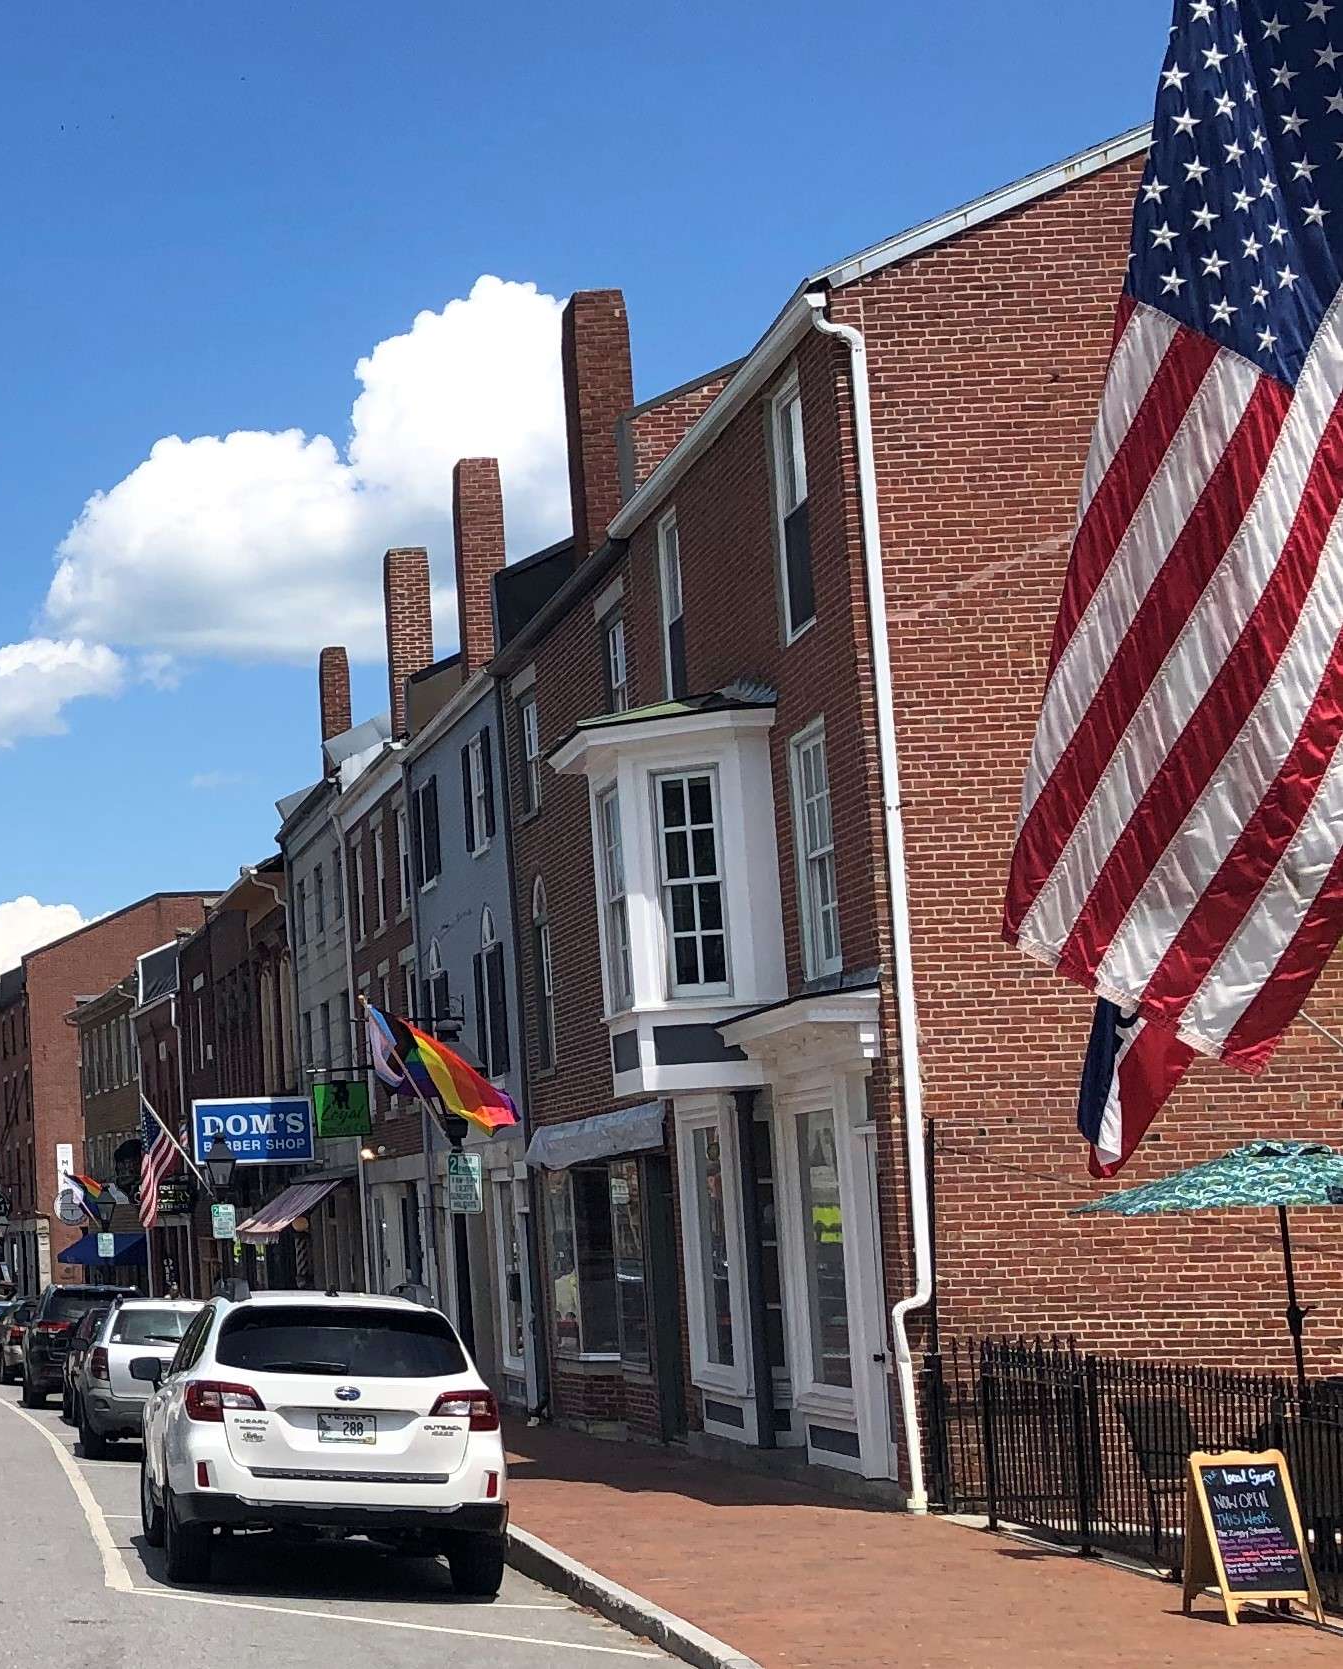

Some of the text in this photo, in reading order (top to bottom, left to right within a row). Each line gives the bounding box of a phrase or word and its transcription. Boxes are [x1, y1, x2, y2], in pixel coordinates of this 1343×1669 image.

[202, 1113, 304, 1136] DOM'S
[204, 1138, 305, 1152] BRBER SHOP
[449, 1156, 457, 1173] 2
[343, 1421, 364, 1436] 288
[1213, 1490, 1269, 1509] NOW OPEN
